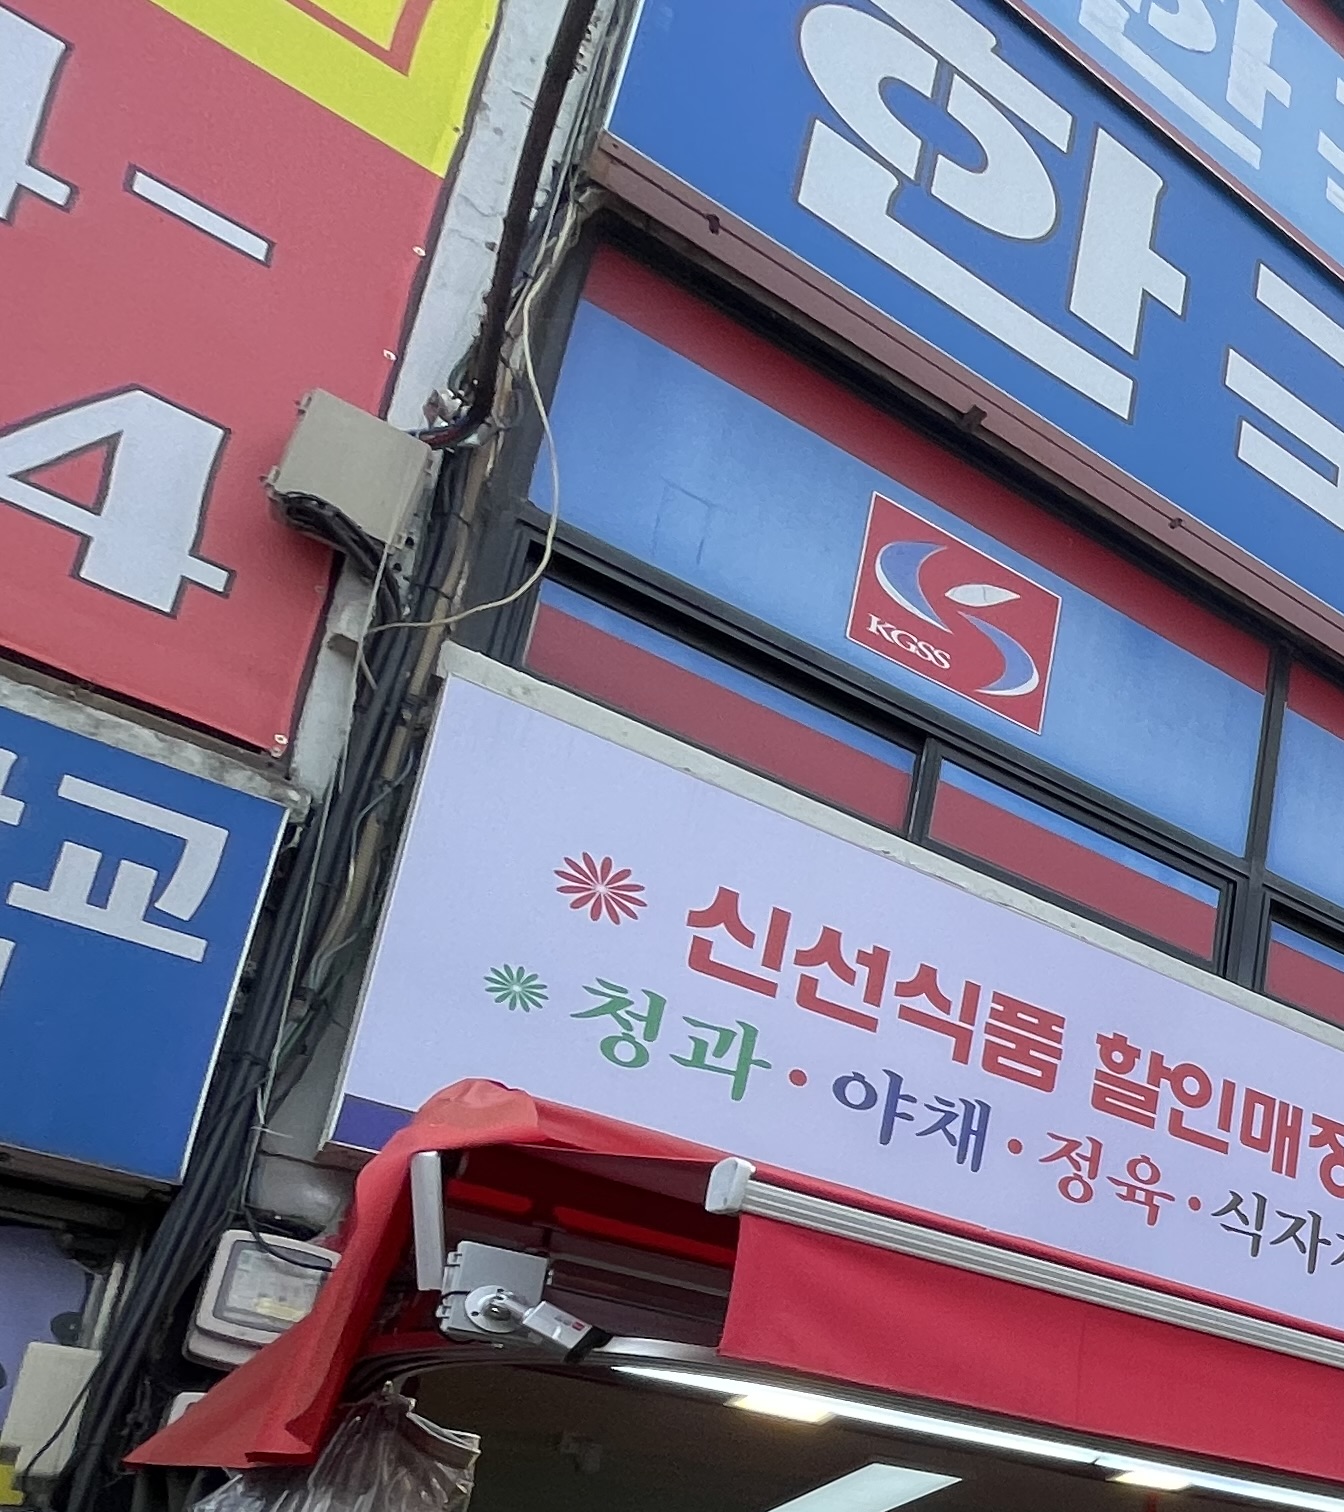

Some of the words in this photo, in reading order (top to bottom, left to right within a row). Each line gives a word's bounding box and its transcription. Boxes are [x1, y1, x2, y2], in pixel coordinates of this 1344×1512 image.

[865, 614, 952, 672] KGSS
[0, 748, 228, 990] 교
[686, 886, 1068, 1093] 신선식품
